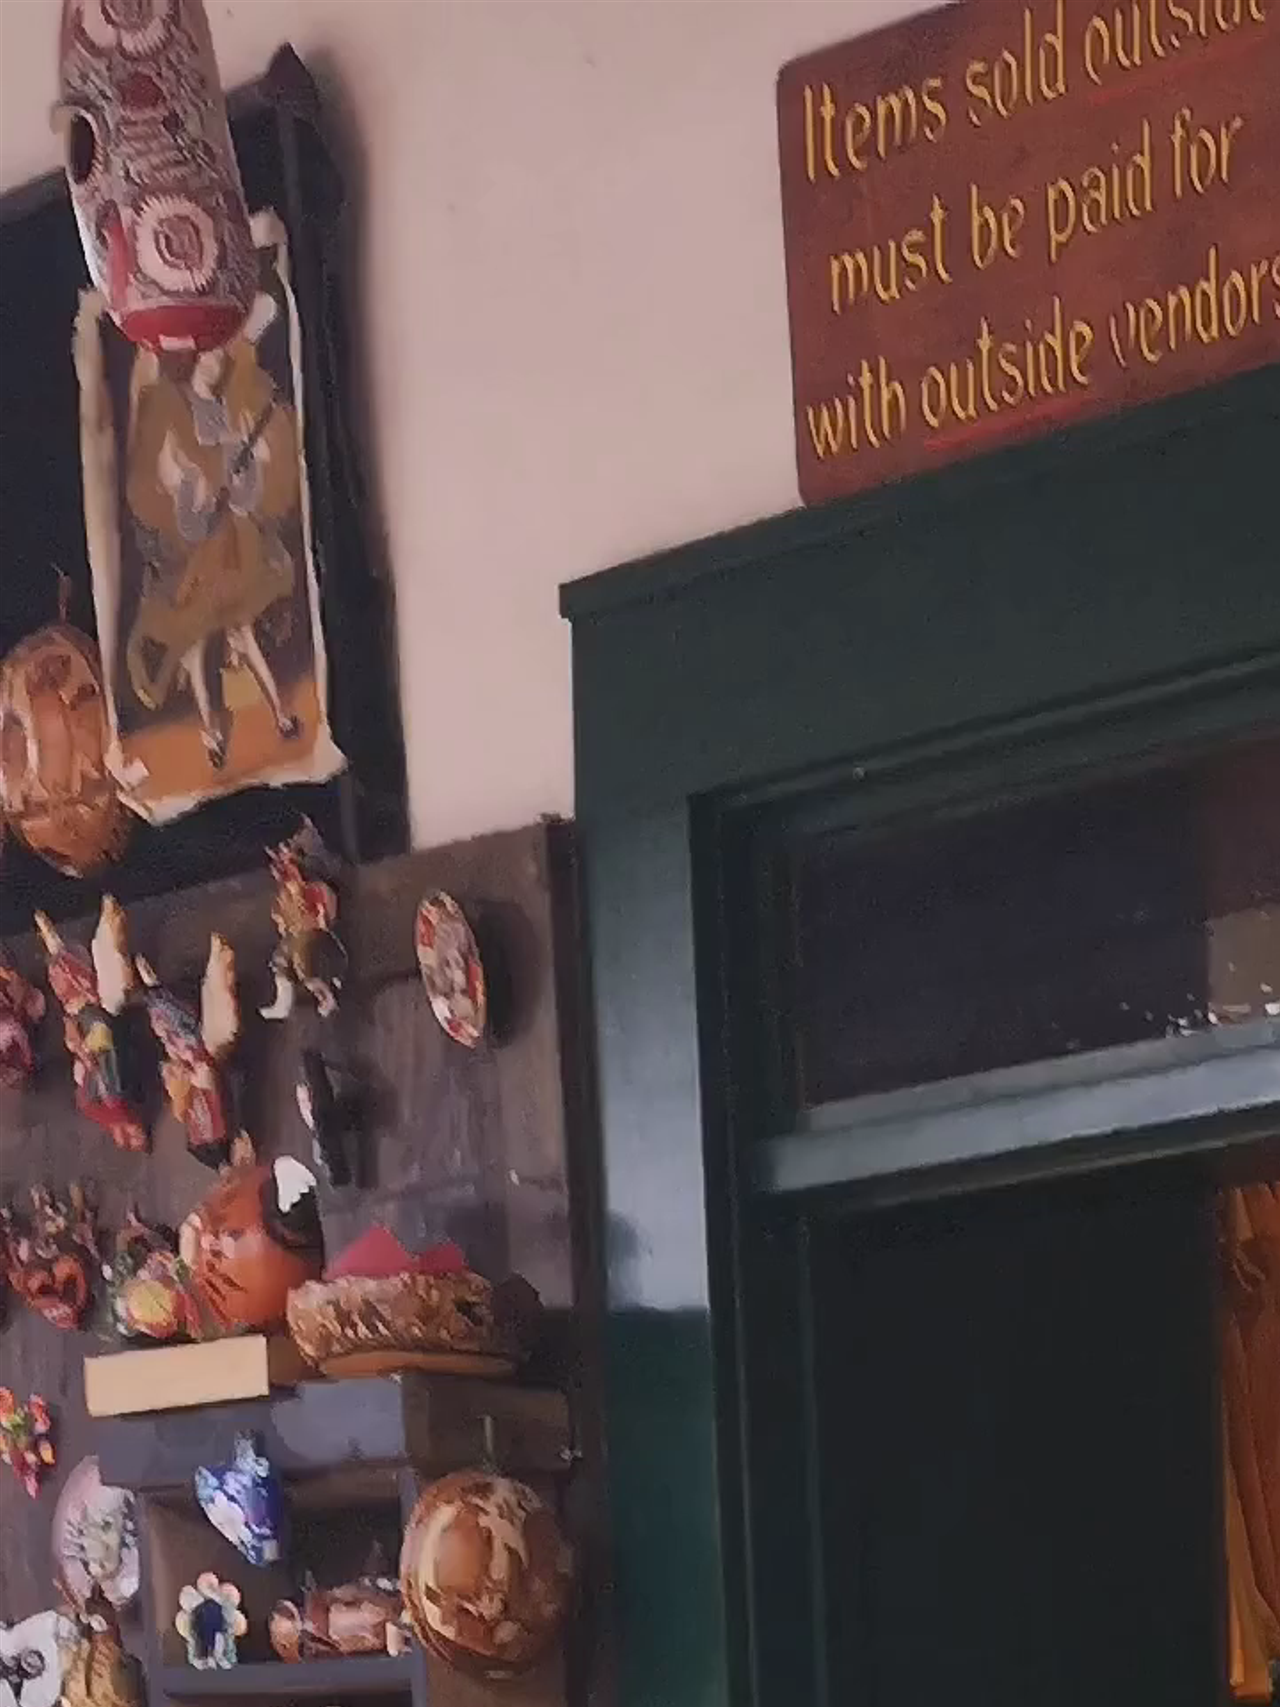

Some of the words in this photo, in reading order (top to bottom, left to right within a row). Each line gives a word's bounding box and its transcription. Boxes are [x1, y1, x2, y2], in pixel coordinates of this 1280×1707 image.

[804, 76, 948, 183] Items
[966, 0, 1067, 127] sold
[830, 194, 953, 314] must
[970, 183, 1026, 271] be
[1047, 118, 1154, 264] paid
[1170, 105, 1245, 199] for
[805, 356, 907, 459] with
[919, 296, 1095, 430] outside
